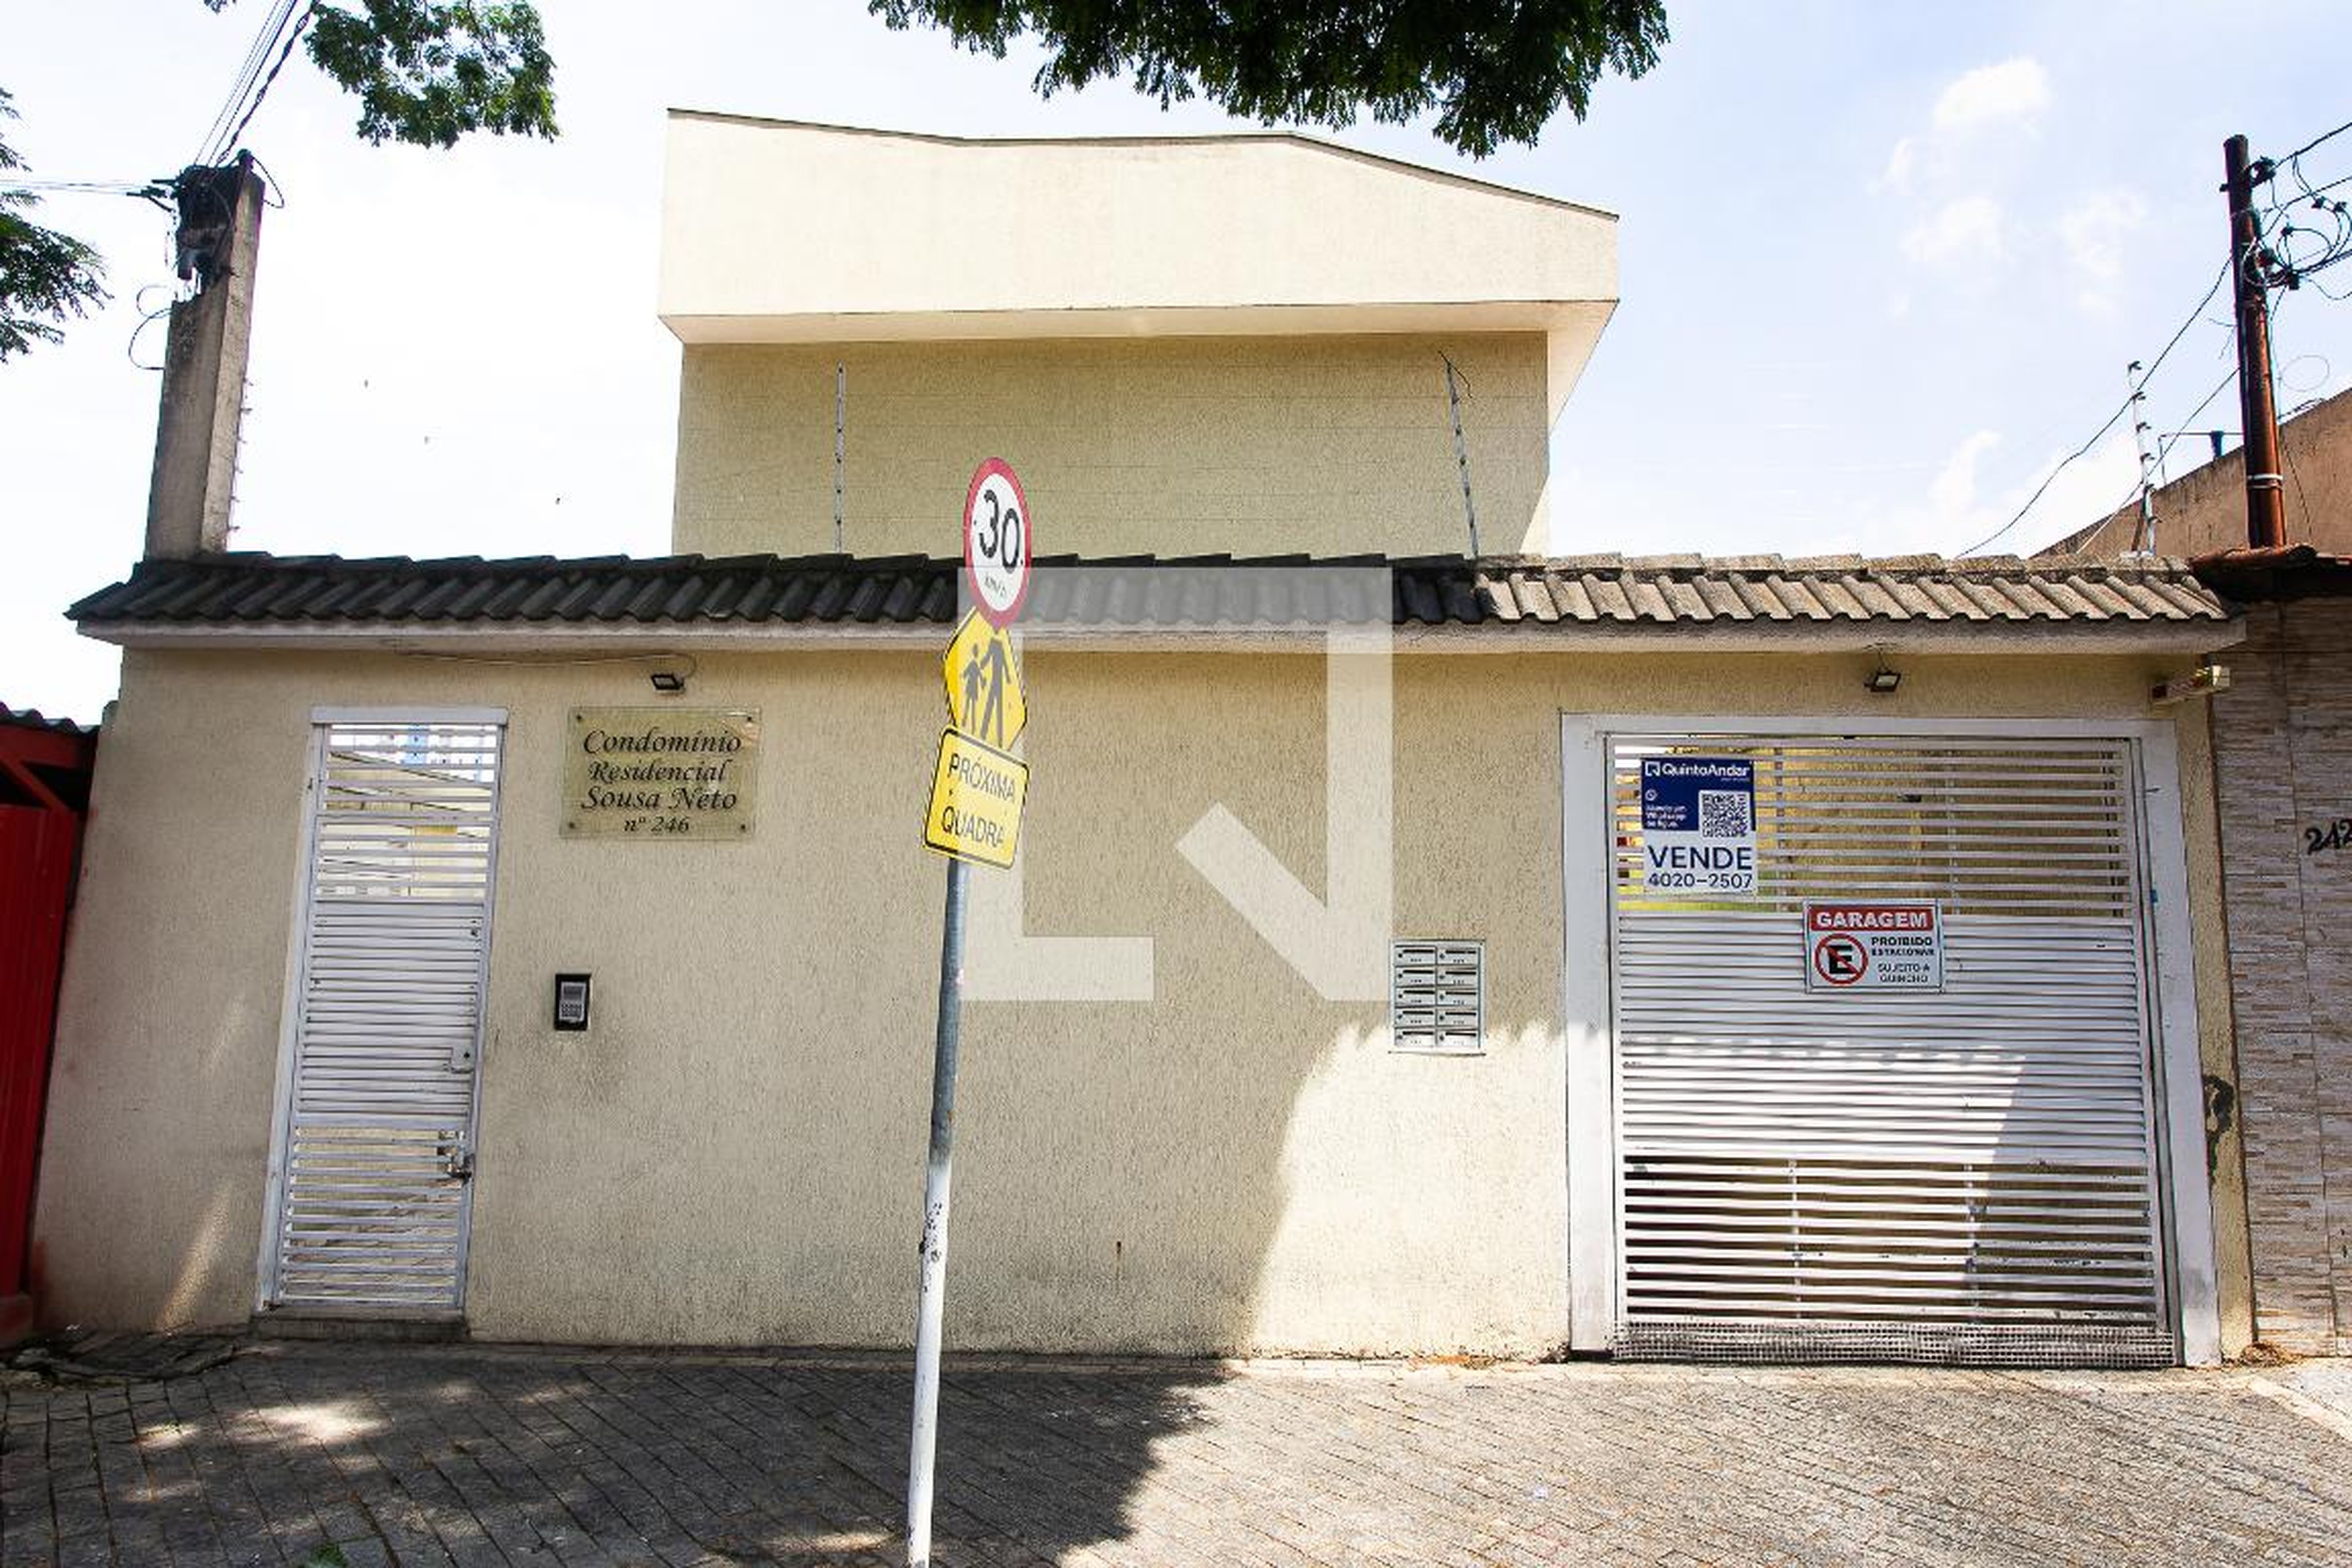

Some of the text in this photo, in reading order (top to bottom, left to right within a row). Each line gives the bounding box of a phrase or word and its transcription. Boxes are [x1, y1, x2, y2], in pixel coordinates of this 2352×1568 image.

[979, 489, 1020, 574] 30
[584, 727, 743, 754] Condomínio
[589, 760, 733, 784] Residencial
[948, 753, 1015, 804] PRÓXIMA
[1662, 763, 1751, 777] QuintoAndar
[581, 786, 737, 810] Sousa Neto
[651, 816, 690, 834] 246
[1648, 845, 1752, 870] VENDE
[1649, 873, 1753, 889] 4020-2507
[1816, 911, 1928, 928] GARAGEM
[1872, 937, 1932, 946] PROIBIDO
